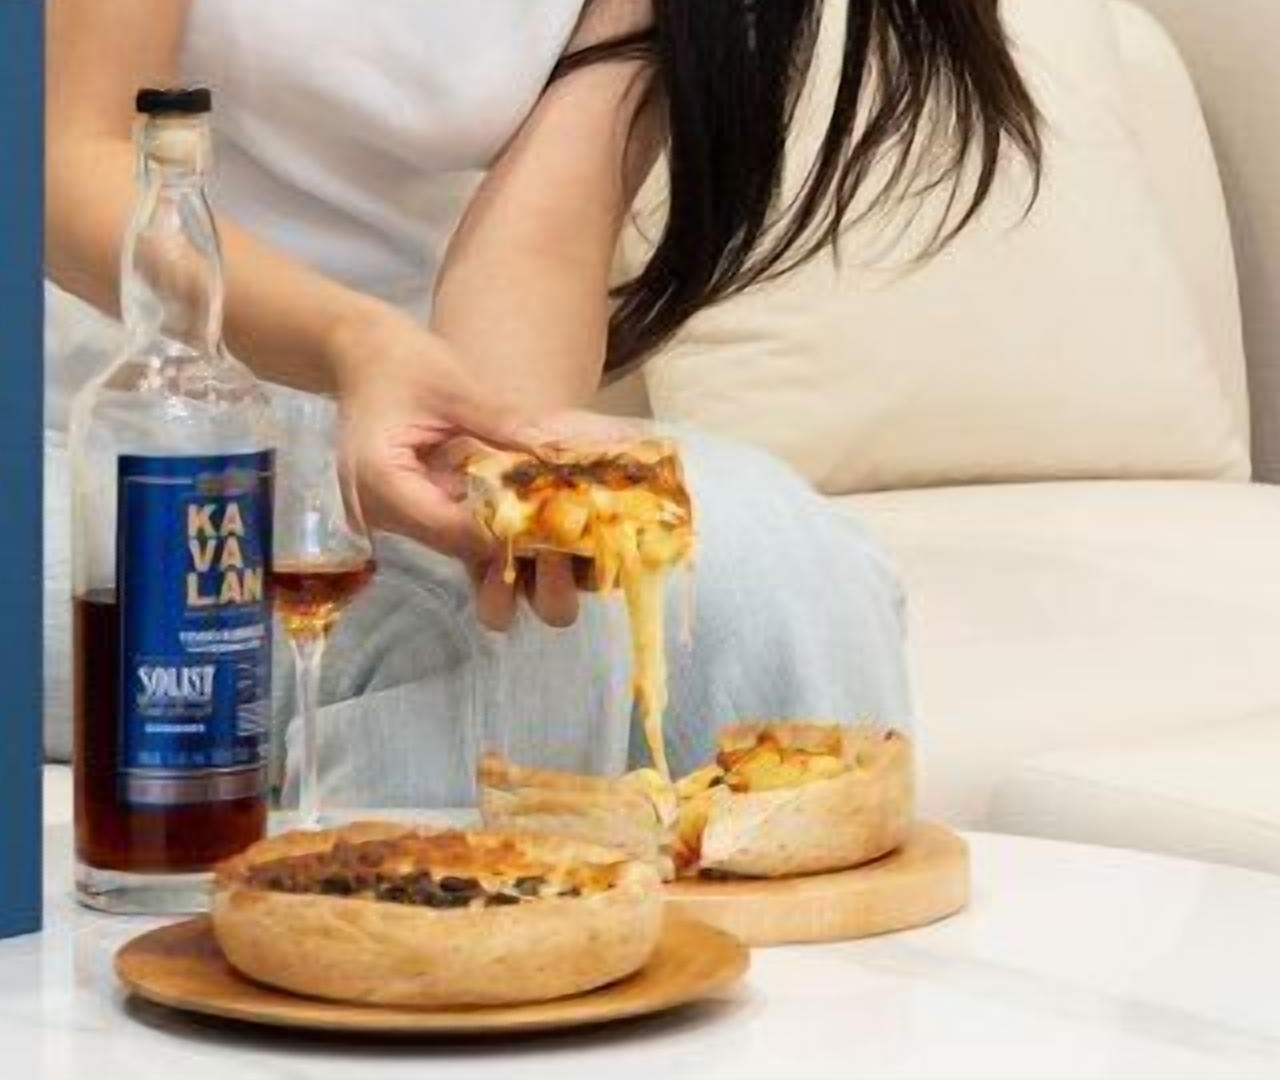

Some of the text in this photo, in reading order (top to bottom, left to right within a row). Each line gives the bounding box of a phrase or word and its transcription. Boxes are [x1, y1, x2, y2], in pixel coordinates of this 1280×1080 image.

[186, 502, 245, 537] KA
[187, 535, 243, 572] VA
[186, 568, 263, 607] LAN
[137, 664, 216, 700] SOLIST
